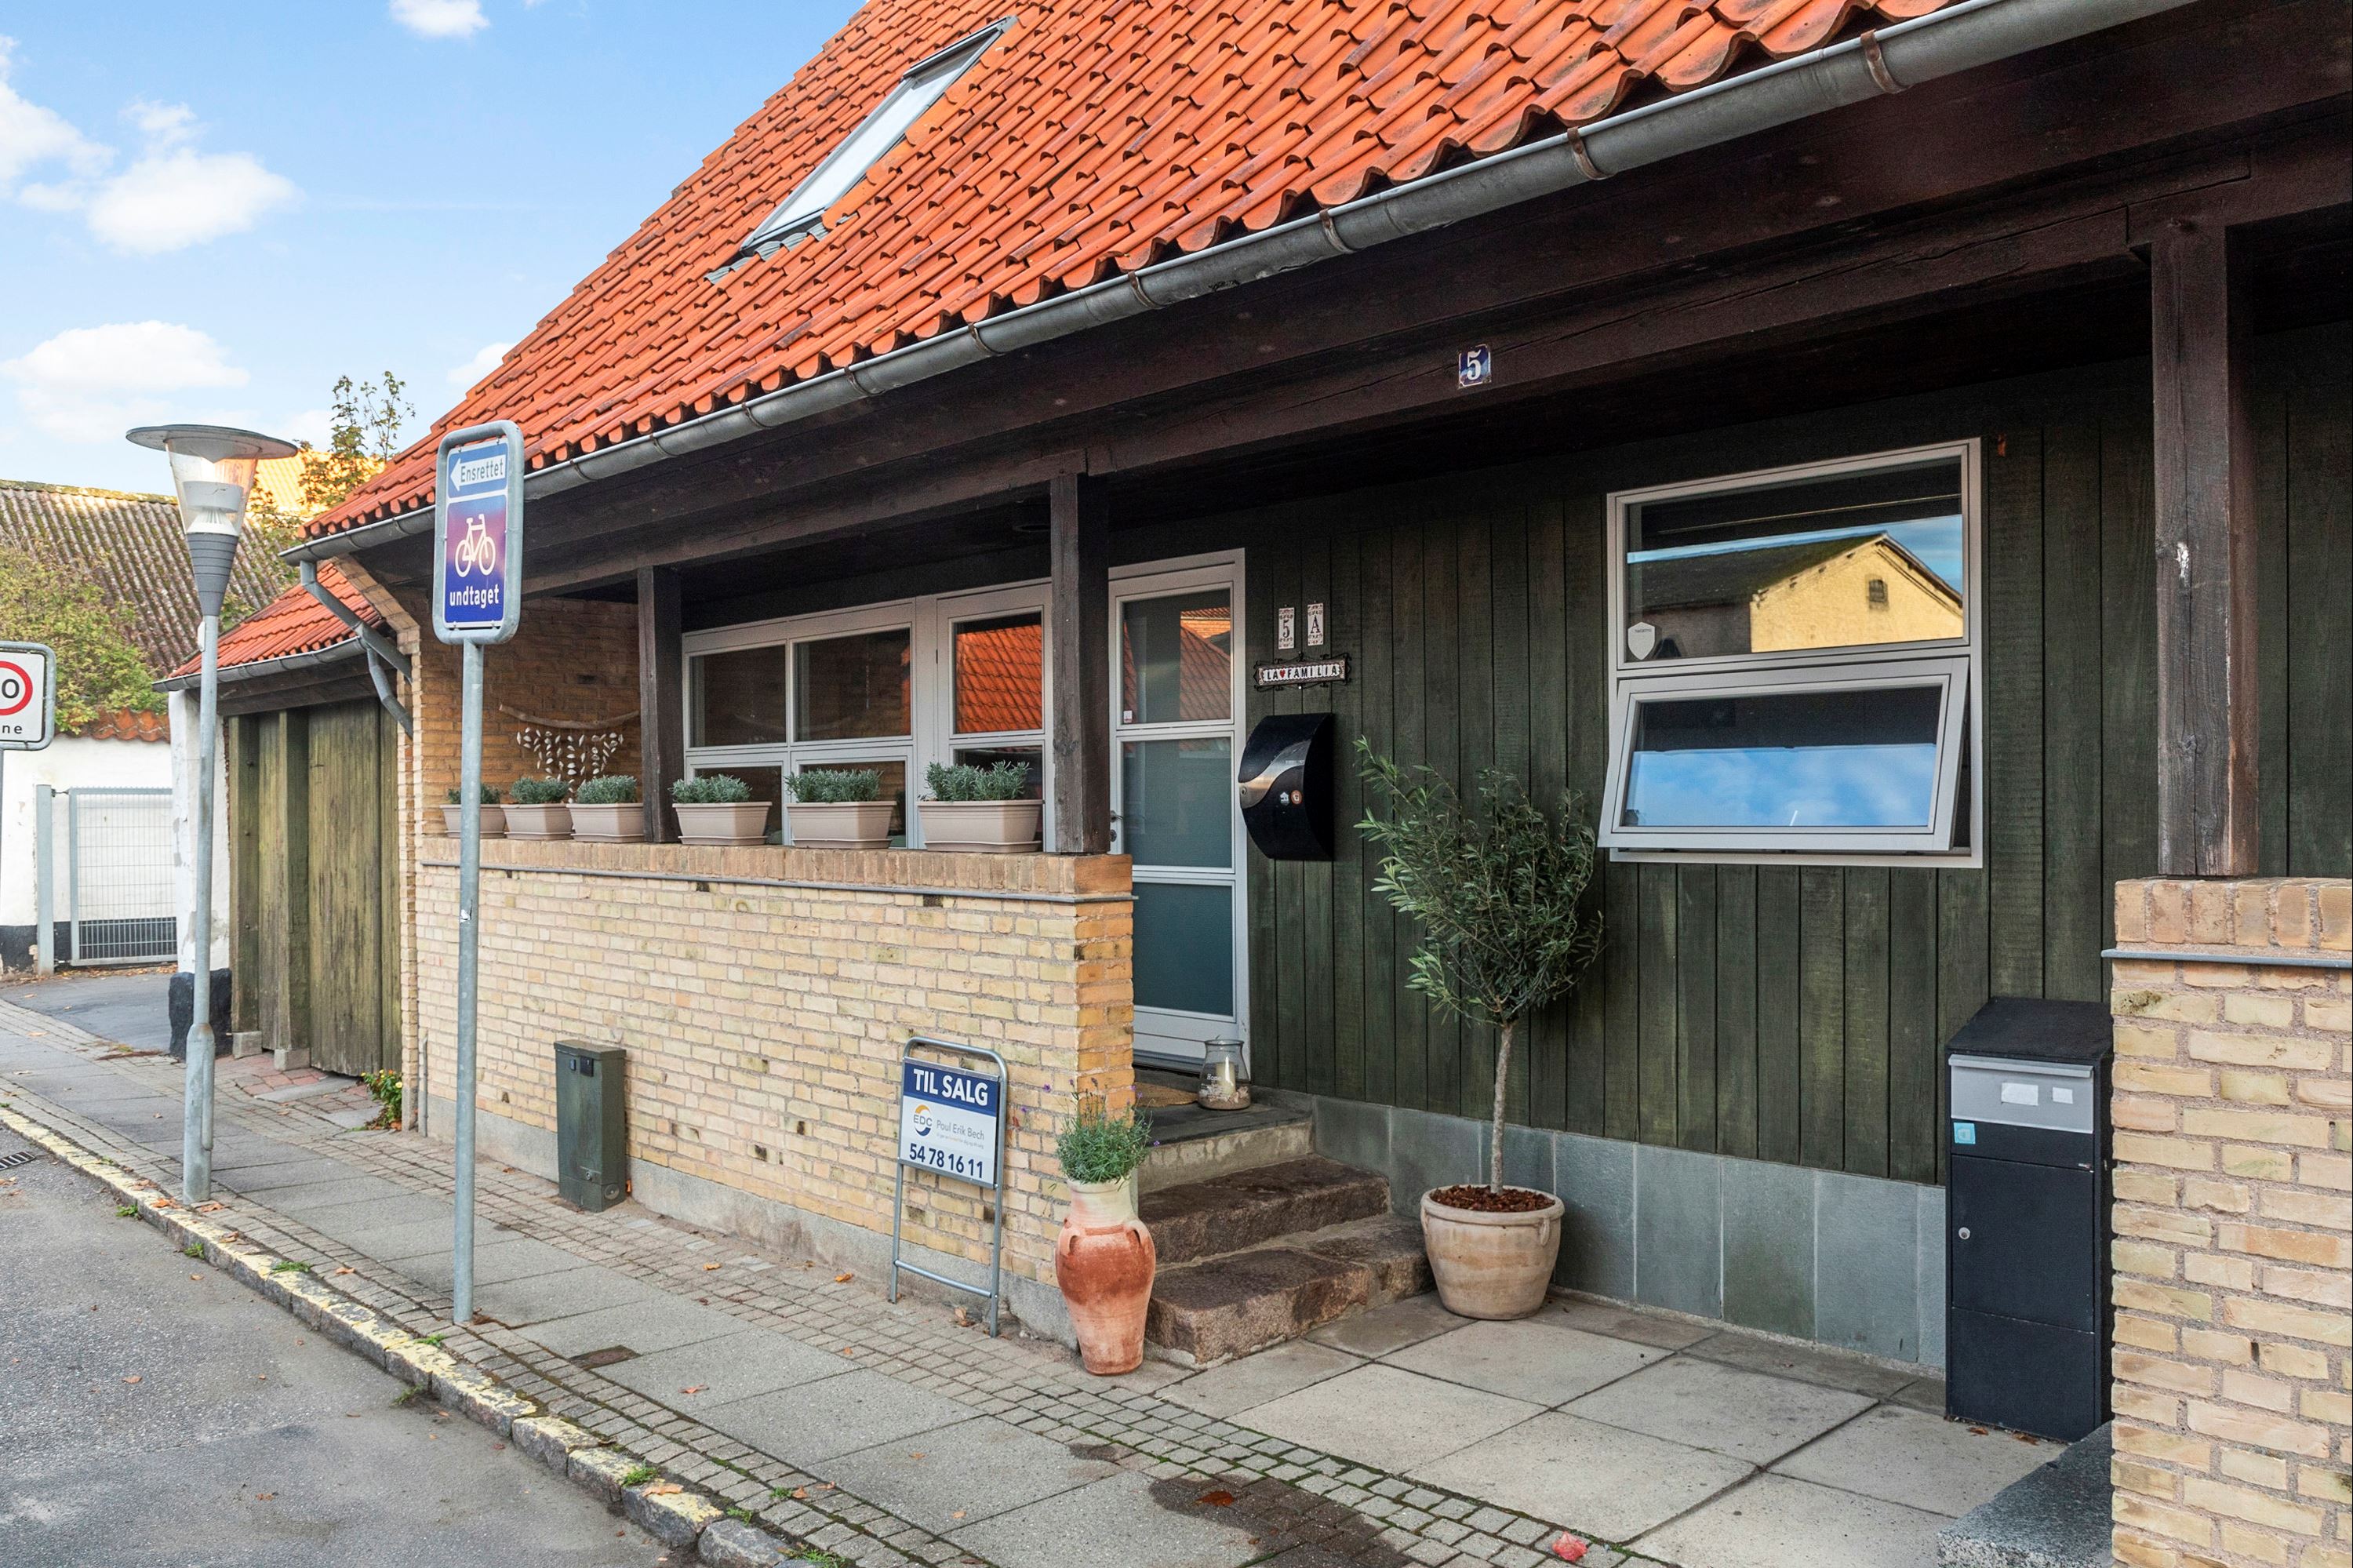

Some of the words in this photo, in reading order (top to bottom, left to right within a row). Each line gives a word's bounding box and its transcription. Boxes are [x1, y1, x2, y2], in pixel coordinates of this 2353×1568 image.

[1467, 349, 1482, 380] 5
[460, 459, 504, 482] Ensrettet
[449, 584, 500, 609] undtaget
[1282, 619, 1290, 638] 5
[1311, 615, 1321, 634] A
[1287, 665, 1338, 678] FAMILIA
[2, 678, 20, 699] 0
[2, 725, 23, 734] ne
[913, 1068, 939, 1095] TIL
[941, 1075, 988, 1106] SALG
[913, 1114, 933, 1126] EDC
[936, 1119, 951, 1132] Poul
[953, 1123, 966, 1135] Erik
[967, 1127, 985, 1141] Bech
[909, 1143, 926, 1162] 54
[929, 1148, 944, 1168] 78
[948, 1153, 965, 1173] 16
[968, 1159, 984, 1178] 11
